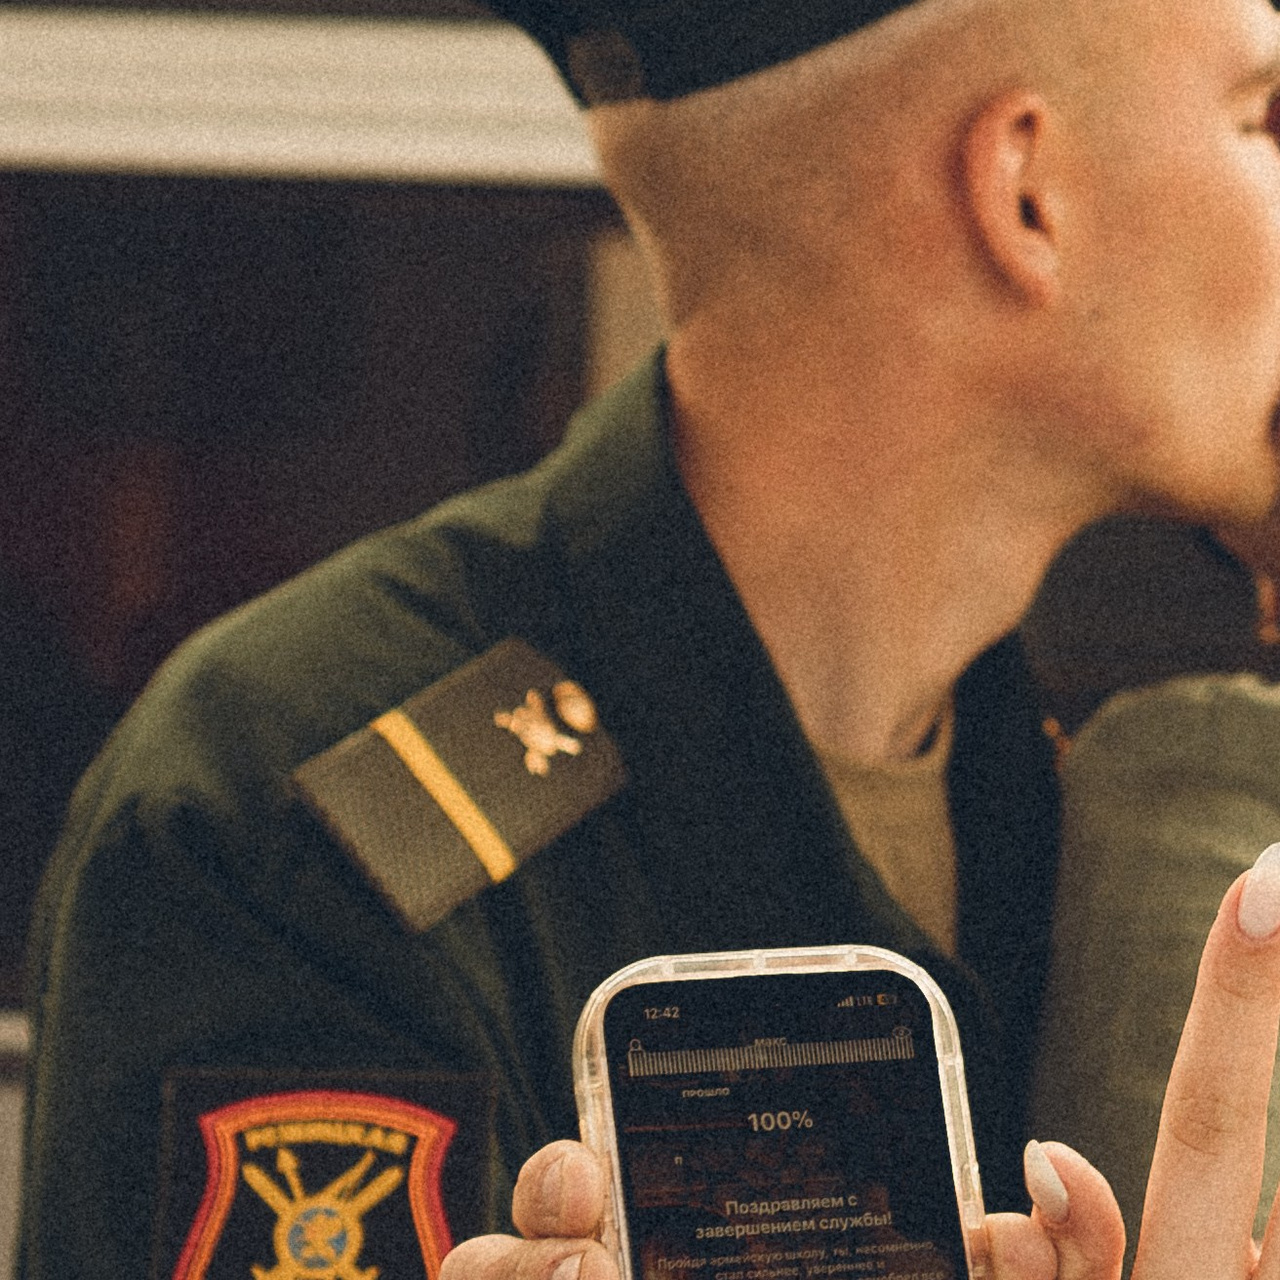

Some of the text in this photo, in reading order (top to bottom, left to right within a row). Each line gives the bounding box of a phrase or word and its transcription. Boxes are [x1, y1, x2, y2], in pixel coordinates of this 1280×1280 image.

[644, 1006, 680, 1020] 12:42
[748, 1109, 813, 1132] 100%
[724, 1194, 858, 1215] Поздравляем с
[695, 1210, 892, 1239] завершением службы!
